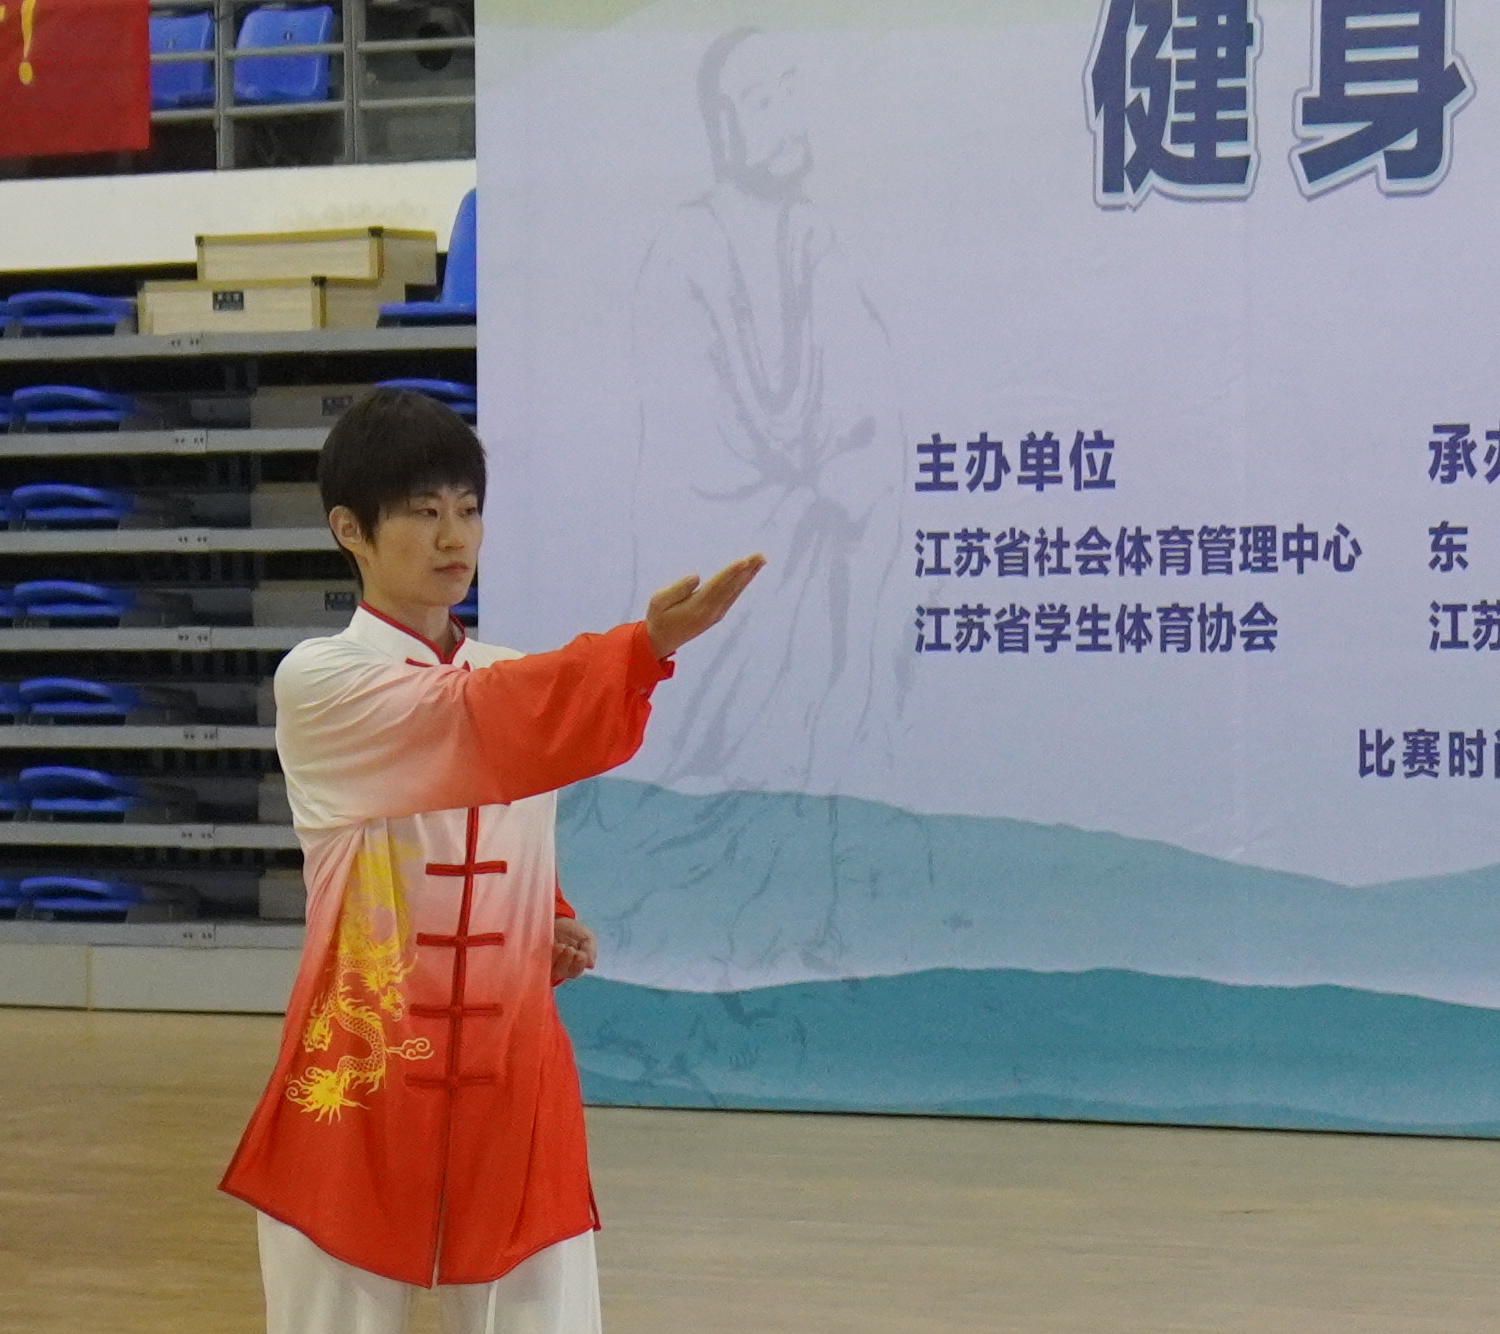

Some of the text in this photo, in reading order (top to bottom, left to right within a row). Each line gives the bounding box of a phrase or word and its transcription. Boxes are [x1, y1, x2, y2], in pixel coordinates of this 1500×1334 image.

[914, 429, 1117, 493] 主办单位
[914, 522, 1363, 578] 江苏省社会体育管理中心
[914, 601, 1279, 654] 江苏省学生体育协会
